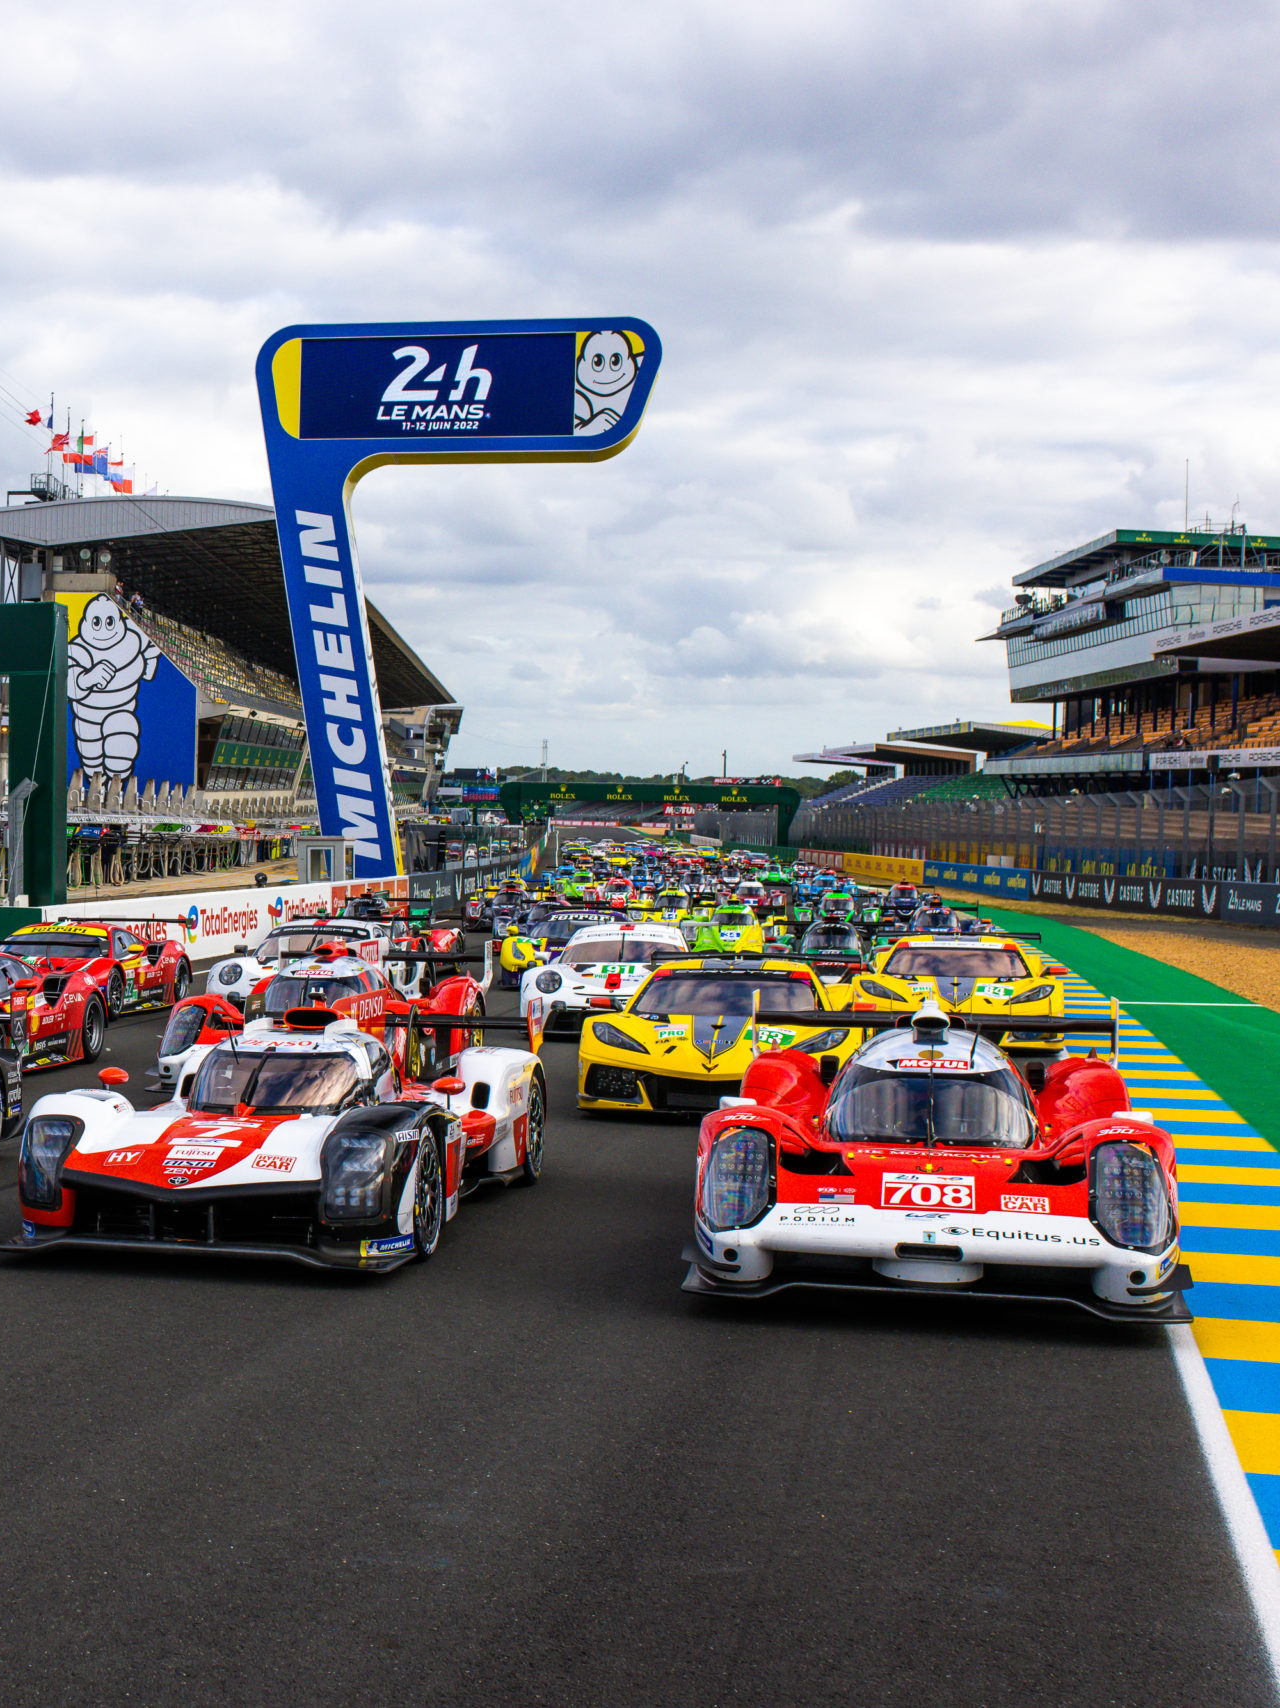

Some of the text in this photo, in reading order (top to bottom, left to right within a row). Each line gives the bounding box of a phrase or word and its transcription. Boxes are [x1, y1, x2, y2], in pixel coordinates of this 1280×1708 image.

[381, 344, 493, 402] 24h
[377, 404, 484, 420] LE MANS
[402, 421, 479, 431] 11-12 JUIN 2022
[295, 510, 382, 860] MICHELIN
[1078, 882, 1100, 899] CASTORE
[1120, 885, 1144, 903] CASTORE
[1167, 889, 1196, 908] CASTORE
[200, 903, 258, 938] TotalEnergies
[549, 914, 616, 922] Ferrari
[31, 926, 88, 934] Ferrari
[607, 965, 630, 974] 91
[359, 996, 383, 1021] DENSO
[758, 1031, 784, 1044] 63
[899, 1059, 968, 1070] MOTUL
[195, 1126, 243, 1138] 7
[110, 1152, 140, 1162] HY
[258, 1155, 293, 1163] HYPER
[890, 1150, 1002, 1159] MOTORCARS
[255, 1160, 291, 1171] CAR
[885, 1183, 972, 1207] 708
[1003, 1196, 1047, 1204] HYPER
[1003, 1201, 1047, 1212] CAR
[972, 1228, 1101, 1246] Equitus.us
[380, 1239, 412, 1250] MICHELIN
